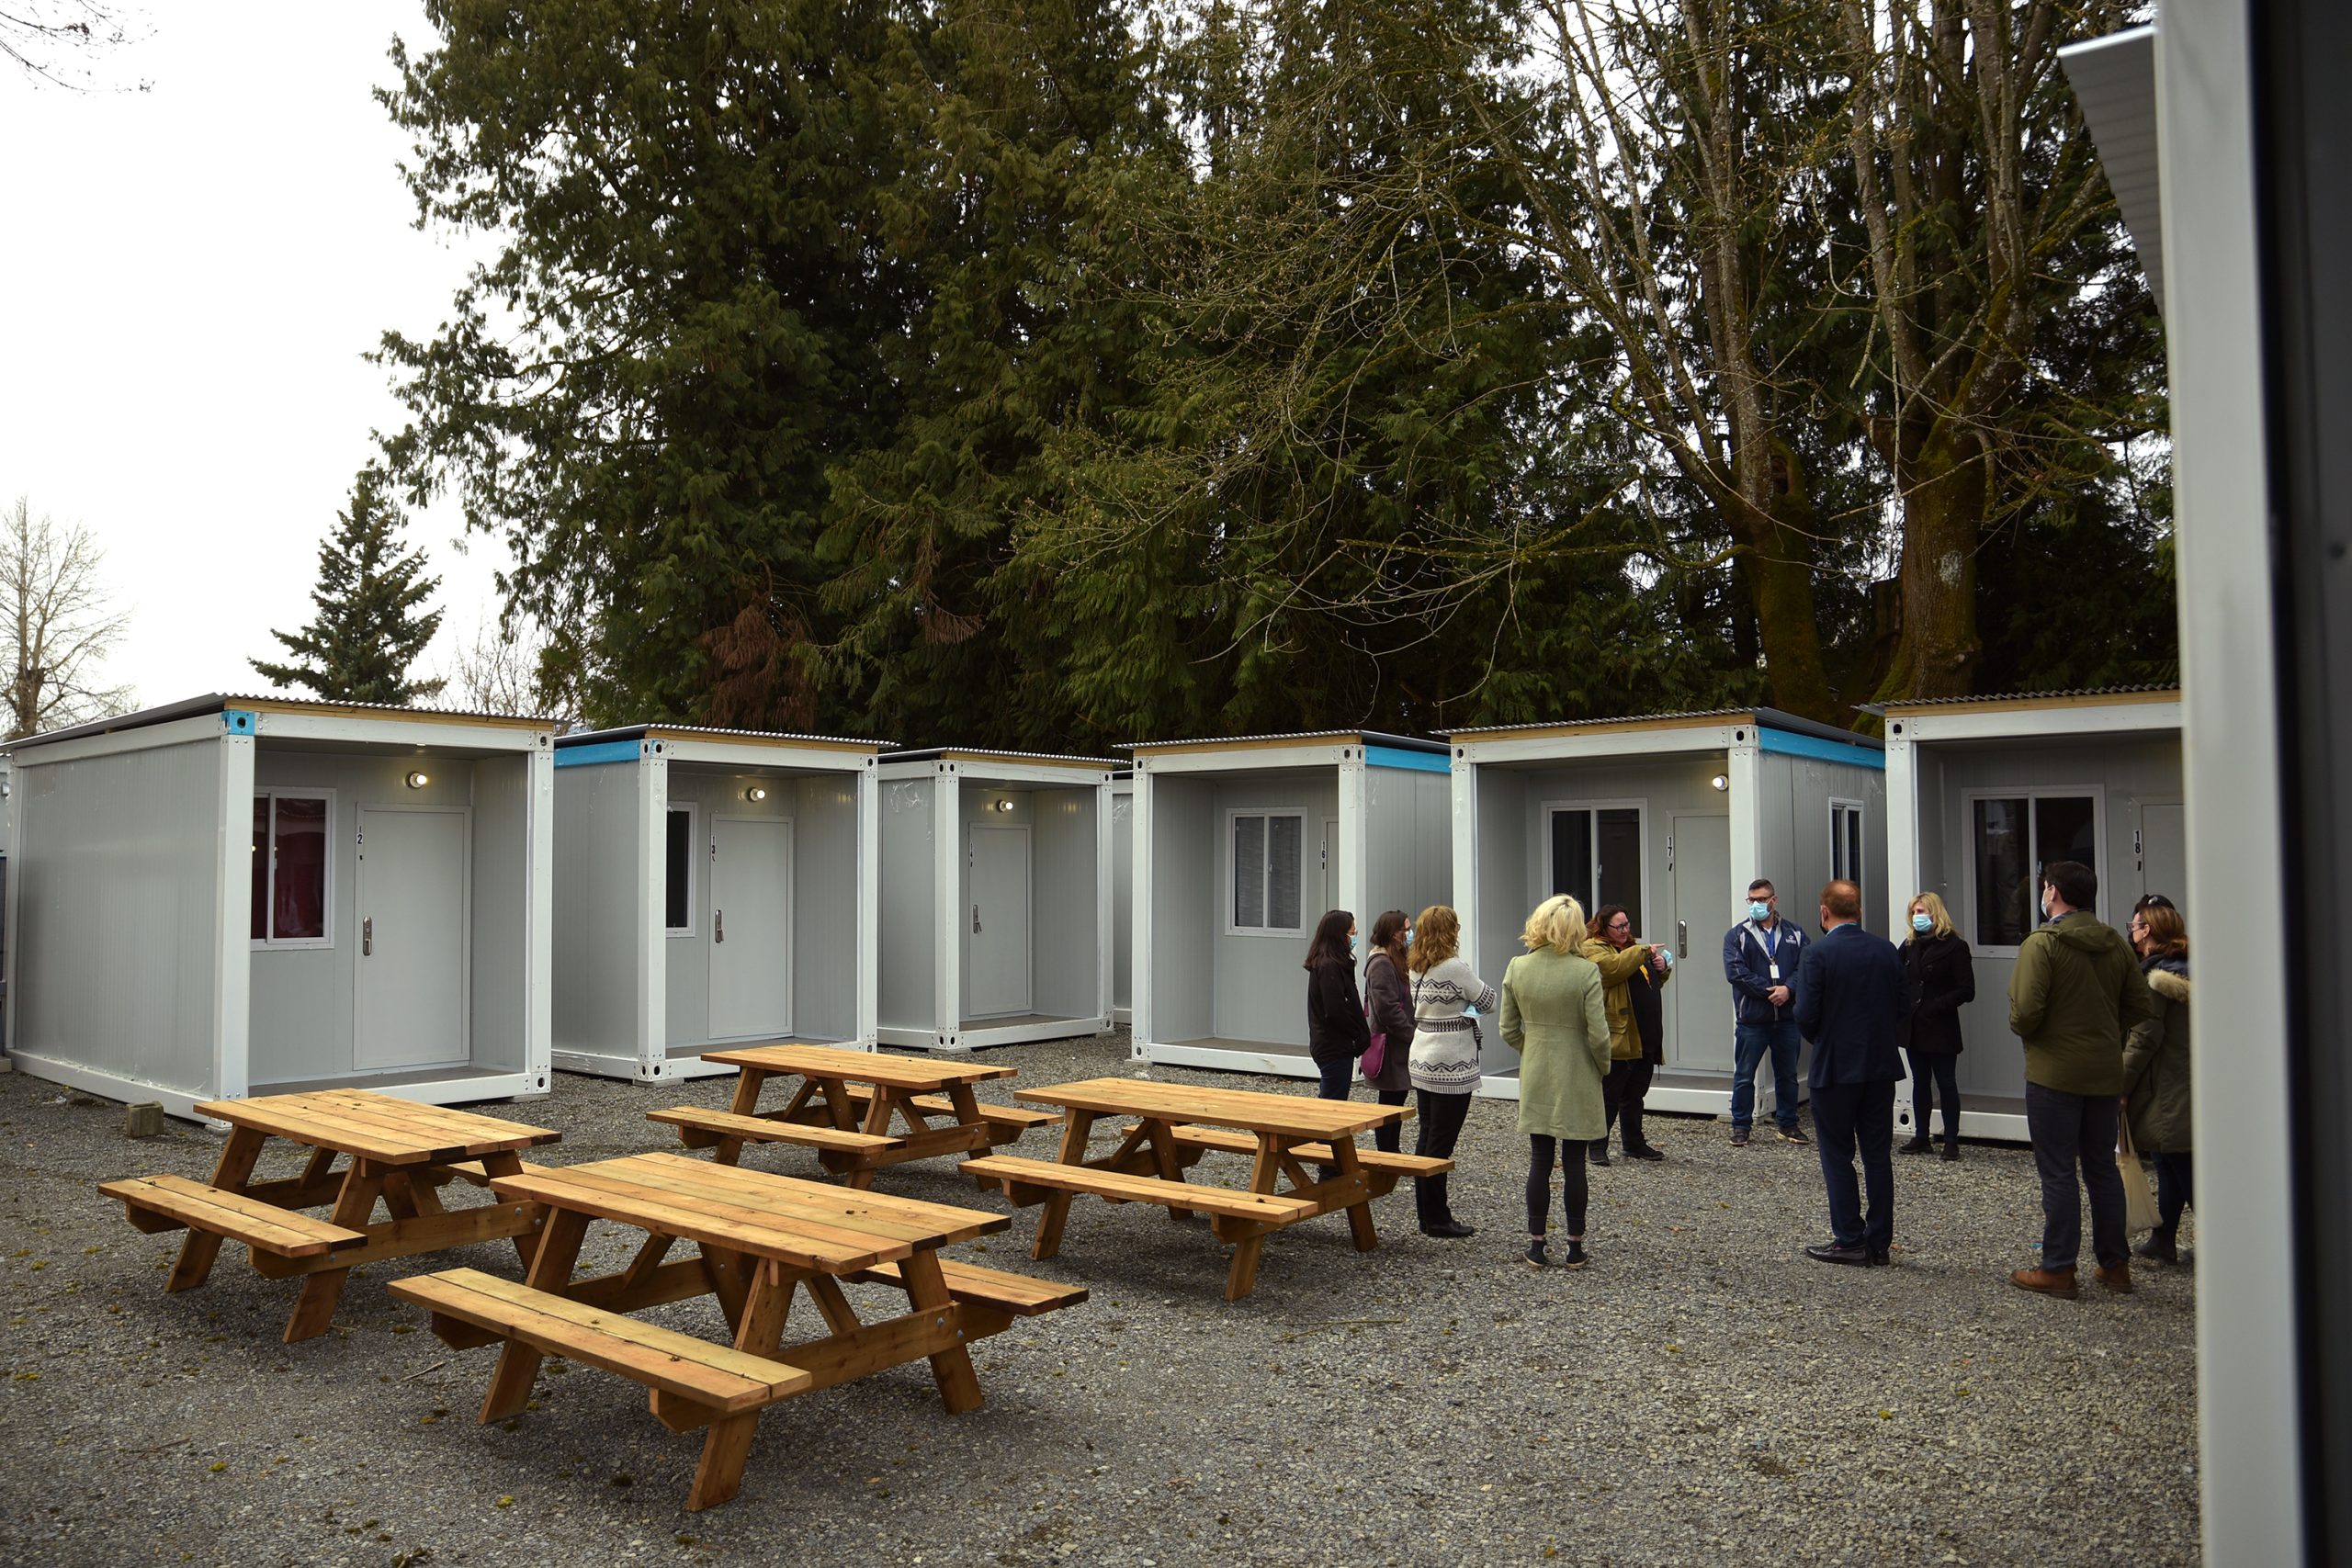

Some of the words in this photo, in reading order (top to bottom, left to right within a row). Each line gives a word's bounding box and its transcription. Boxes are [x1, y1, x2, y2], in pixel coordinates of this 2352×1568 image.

[357, 825, 363, 845] 12
[2134, 829, 2141, 854] 18
[1321, 840, 1326, 859] 16
[1668, 836, 1673, 857] 17
